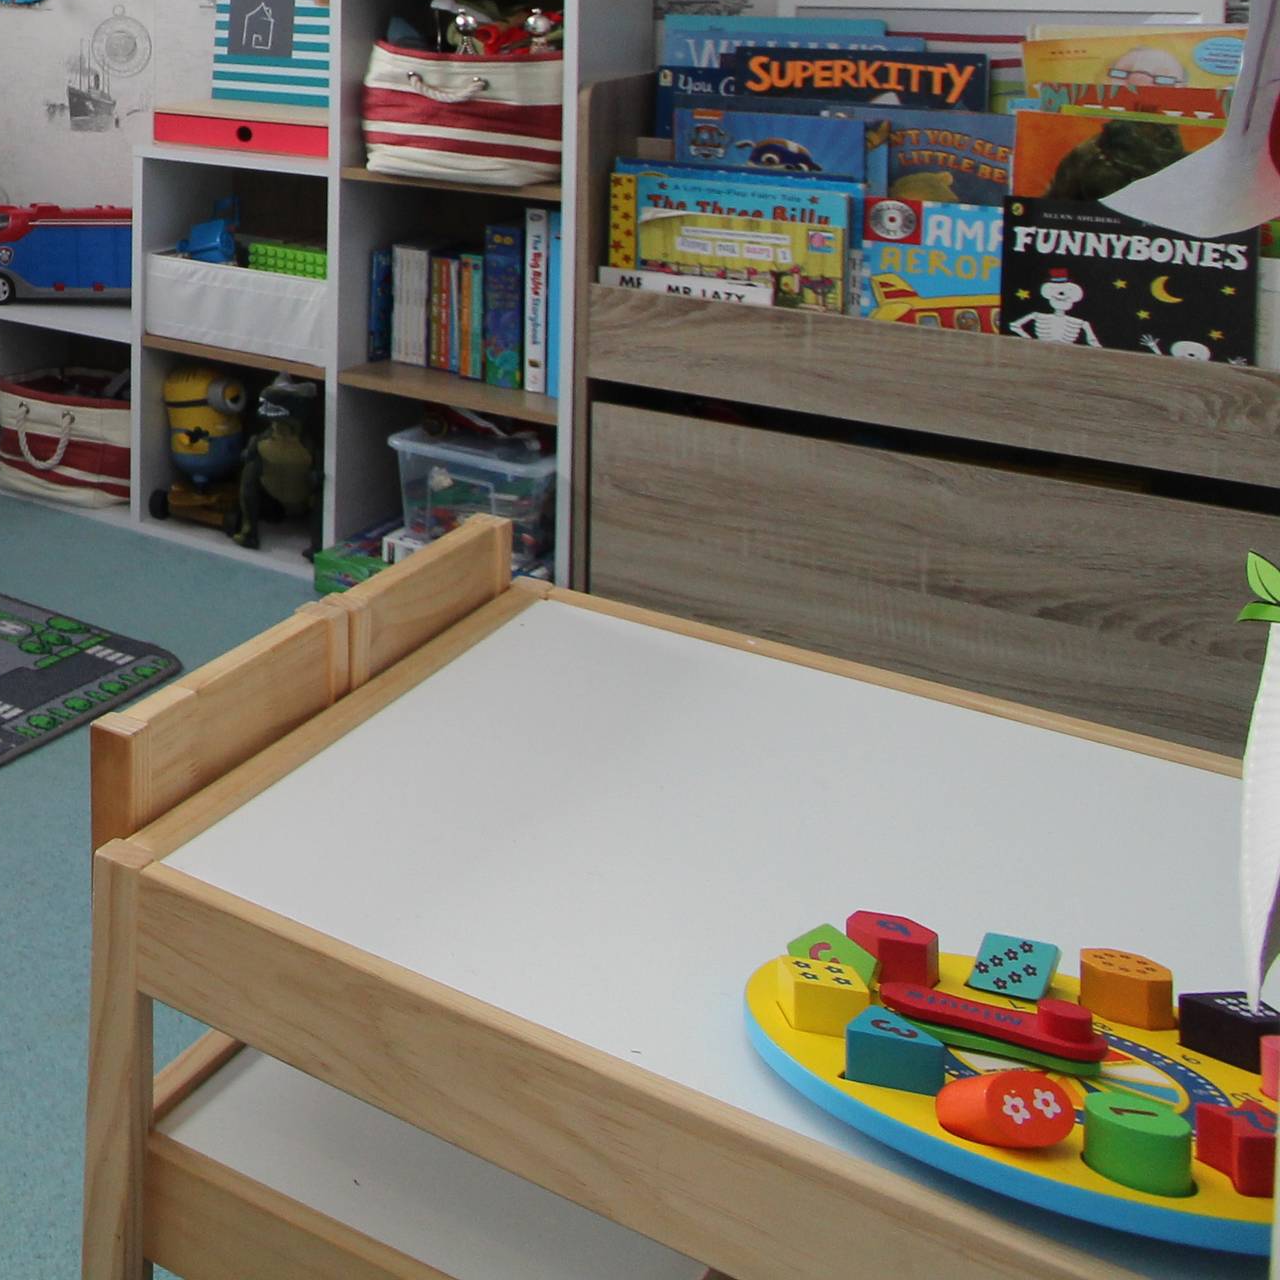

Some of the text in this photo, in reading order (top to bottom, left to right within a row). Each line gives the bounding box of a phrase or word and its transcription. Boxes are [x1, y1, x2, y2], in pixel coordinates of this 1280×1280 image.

[677, 73, 713, 95] You
[746, 55, 976, 104] SUPERKITTY
[925, 128, 970, 151] YOU
[973, 138, 1011, 164] SLE
[898, 149, 1009, 185] LITTLE BE
[925, 214, 1003, 253] AMA
[1012, 225, 1249, 271] FUNNYBONES
[879, 247, 1001, 281] AEROP
[528, 297, 541, 345] Storybook
